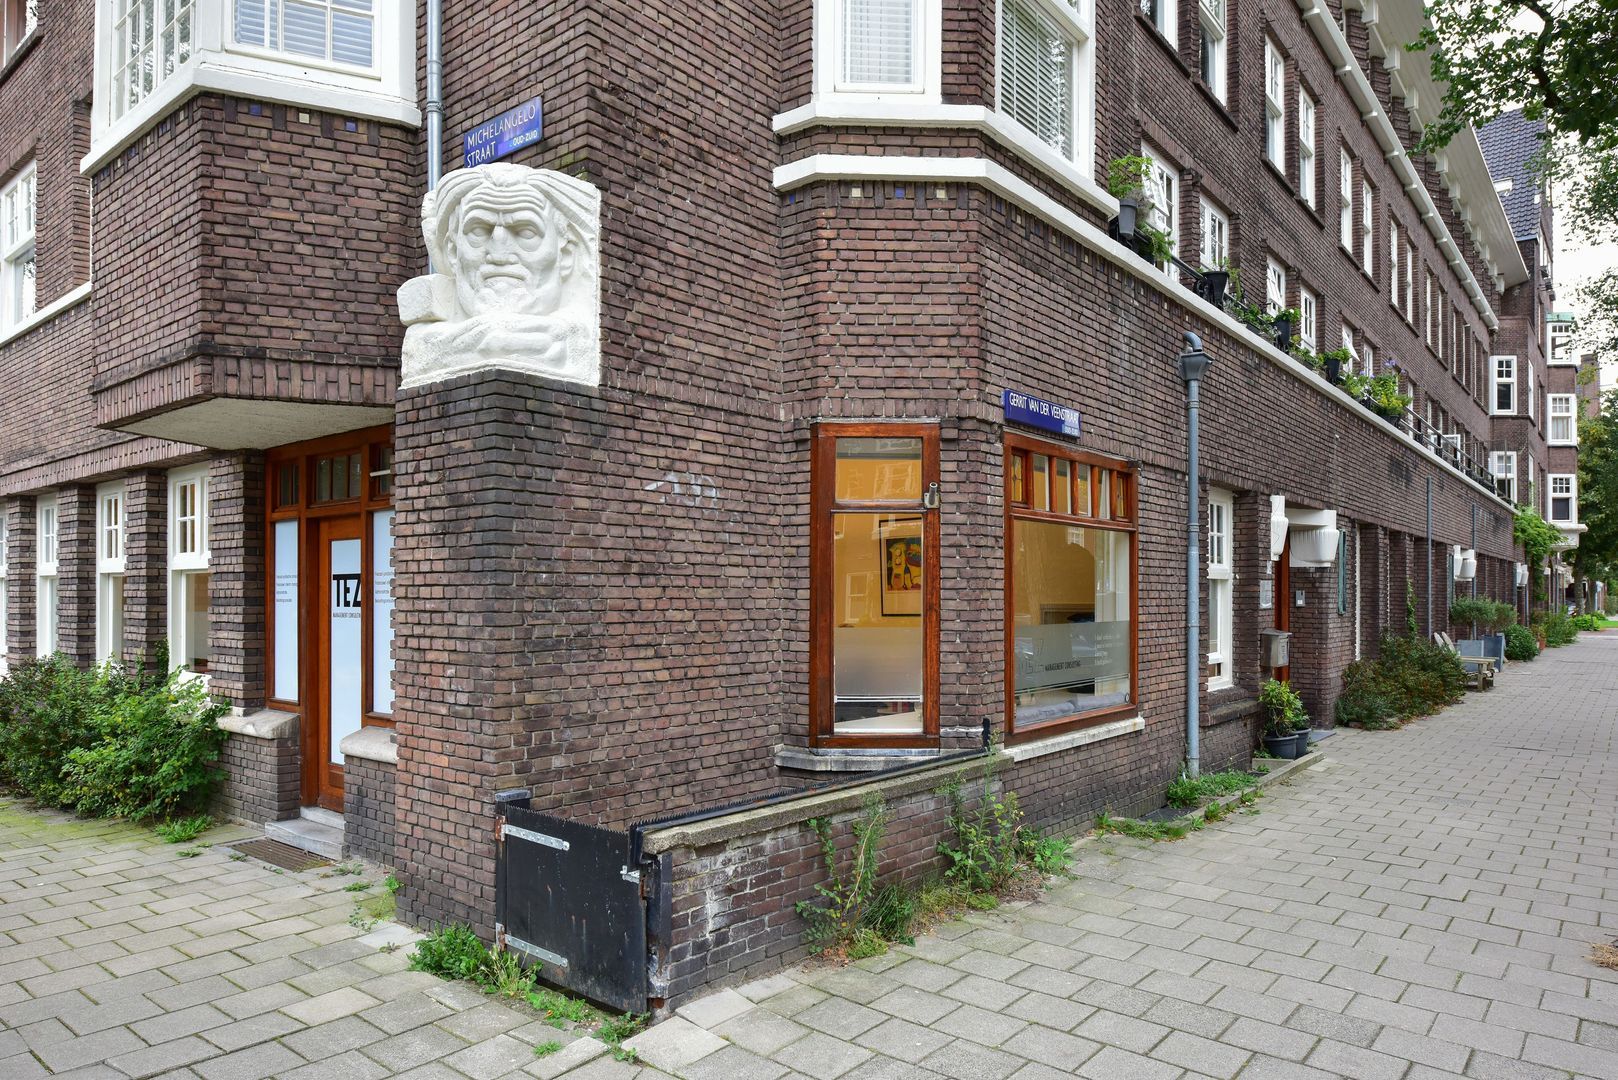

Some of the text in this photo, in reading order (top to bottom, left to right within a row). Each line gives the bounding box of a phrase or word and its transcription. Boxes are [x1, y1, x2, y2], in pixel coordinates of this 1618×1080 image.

[467, 105, 535, 149] MICHELANGELO
[513, 130, 538, 146] OUD-ZUID
[467, 141, 496, 168] STRAAT
[1009, 393, 1079, 424] GERRIT VAN DER VEENSTRAAT
[333, 573, 361, 607] TEZ
